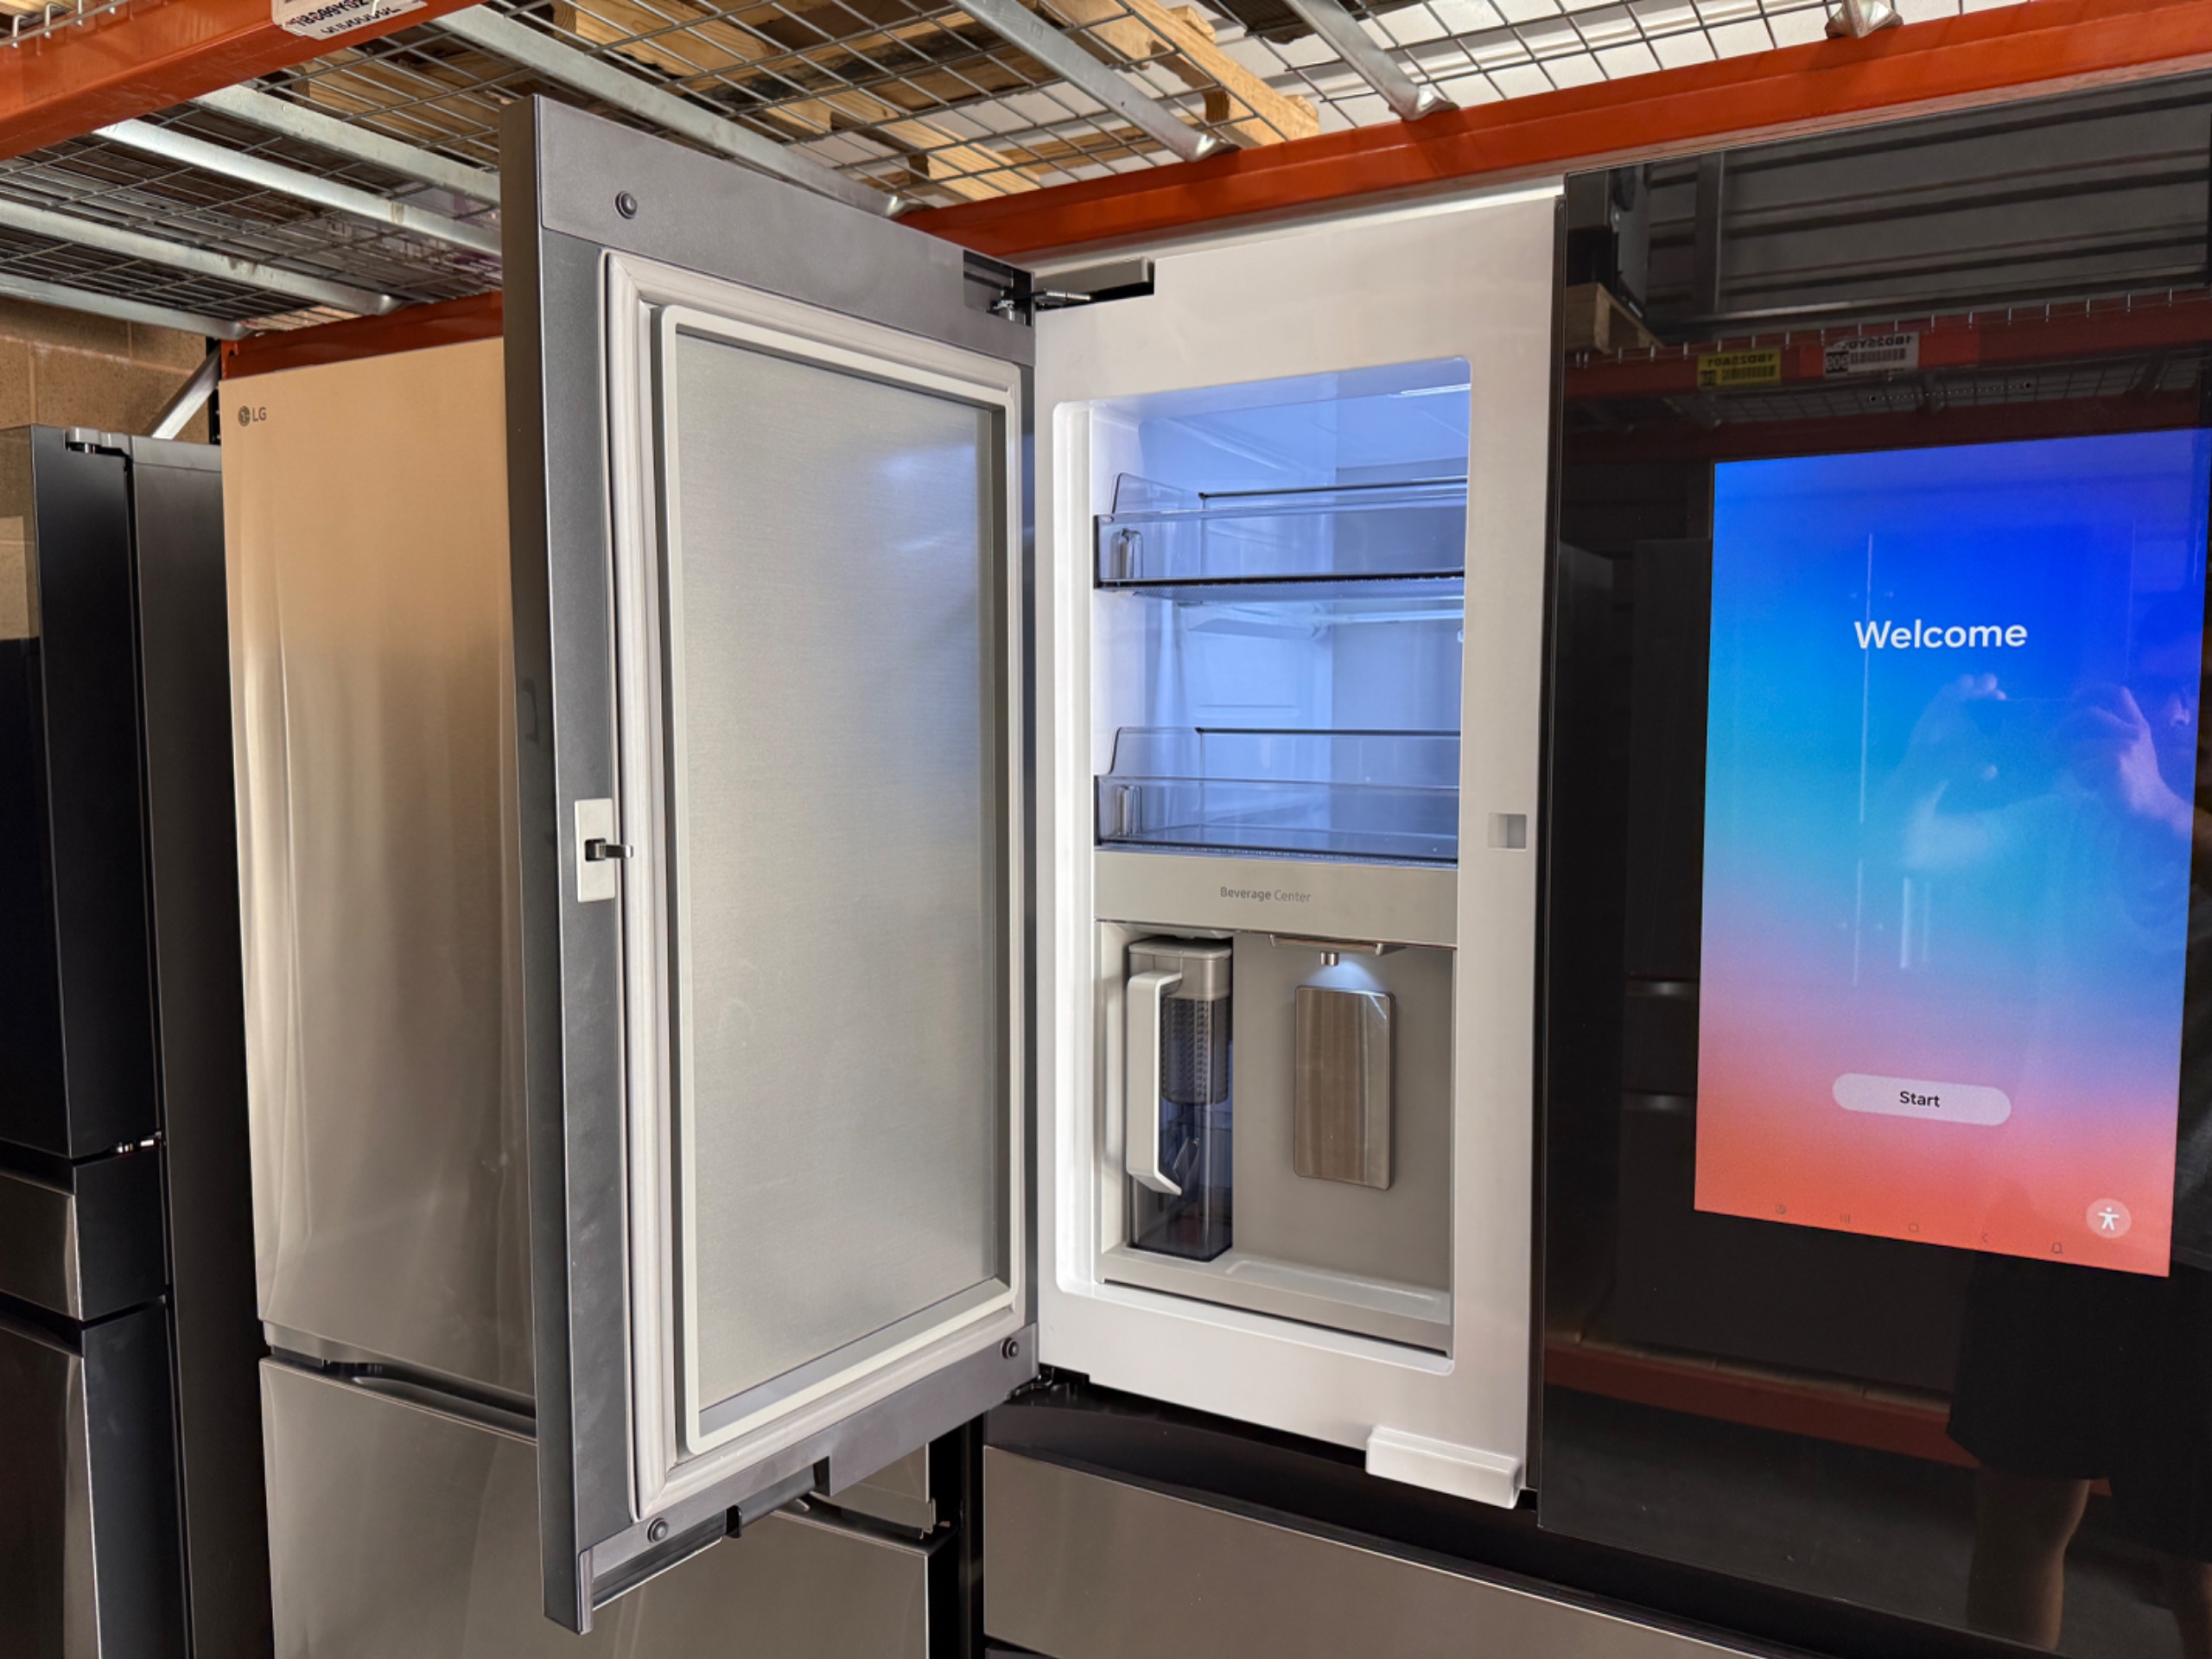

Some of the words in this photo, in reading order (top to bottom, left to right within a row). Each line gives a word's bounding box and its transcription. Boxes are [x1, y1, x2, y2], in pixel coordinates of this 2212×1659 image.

[251, 406, 267, 423] LG
[1853, 619, 2028, 650] Welcome
[1220, 885, 1272, 902] Beverage
[1274, 889, 1312, 903] Center
[1899, 1090, 1941, 1108] Start
